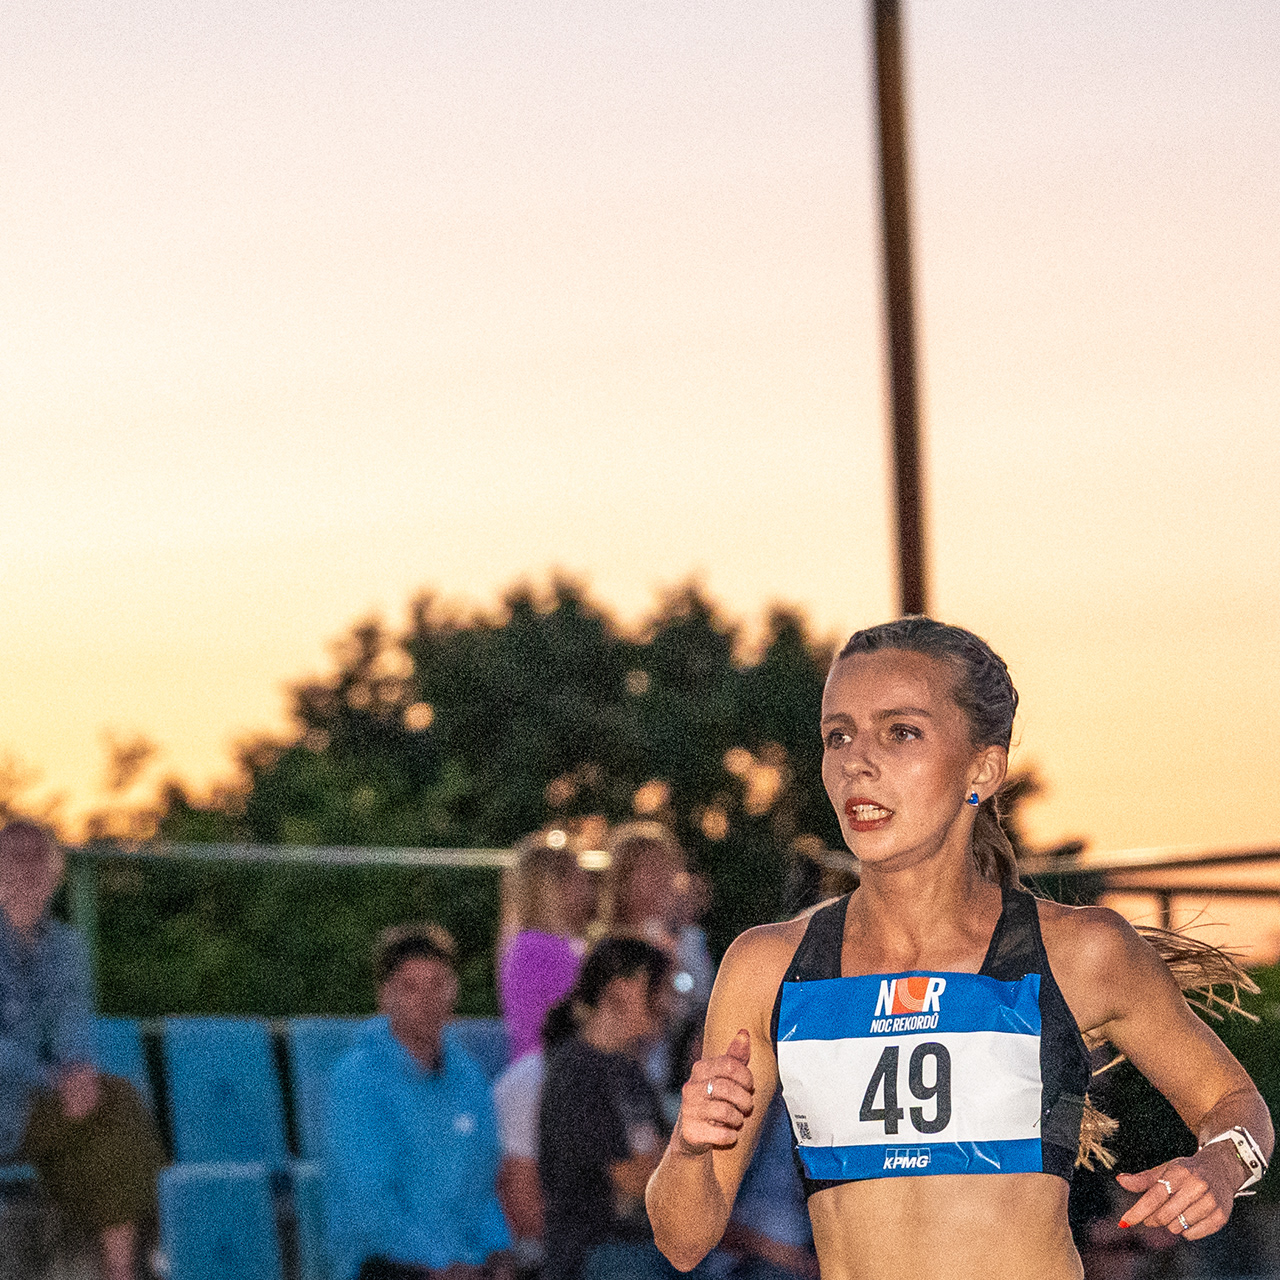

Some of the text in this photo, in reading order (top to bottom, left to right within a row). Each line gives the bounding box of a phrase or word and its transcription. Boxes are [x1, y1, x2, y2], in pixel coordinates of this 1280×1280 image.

[869, 1012, 939, 1034] NOC REKORDŮ
[859, 1041, 952, 1135] 49
[882, 1155, 930, 1170] KPMG
